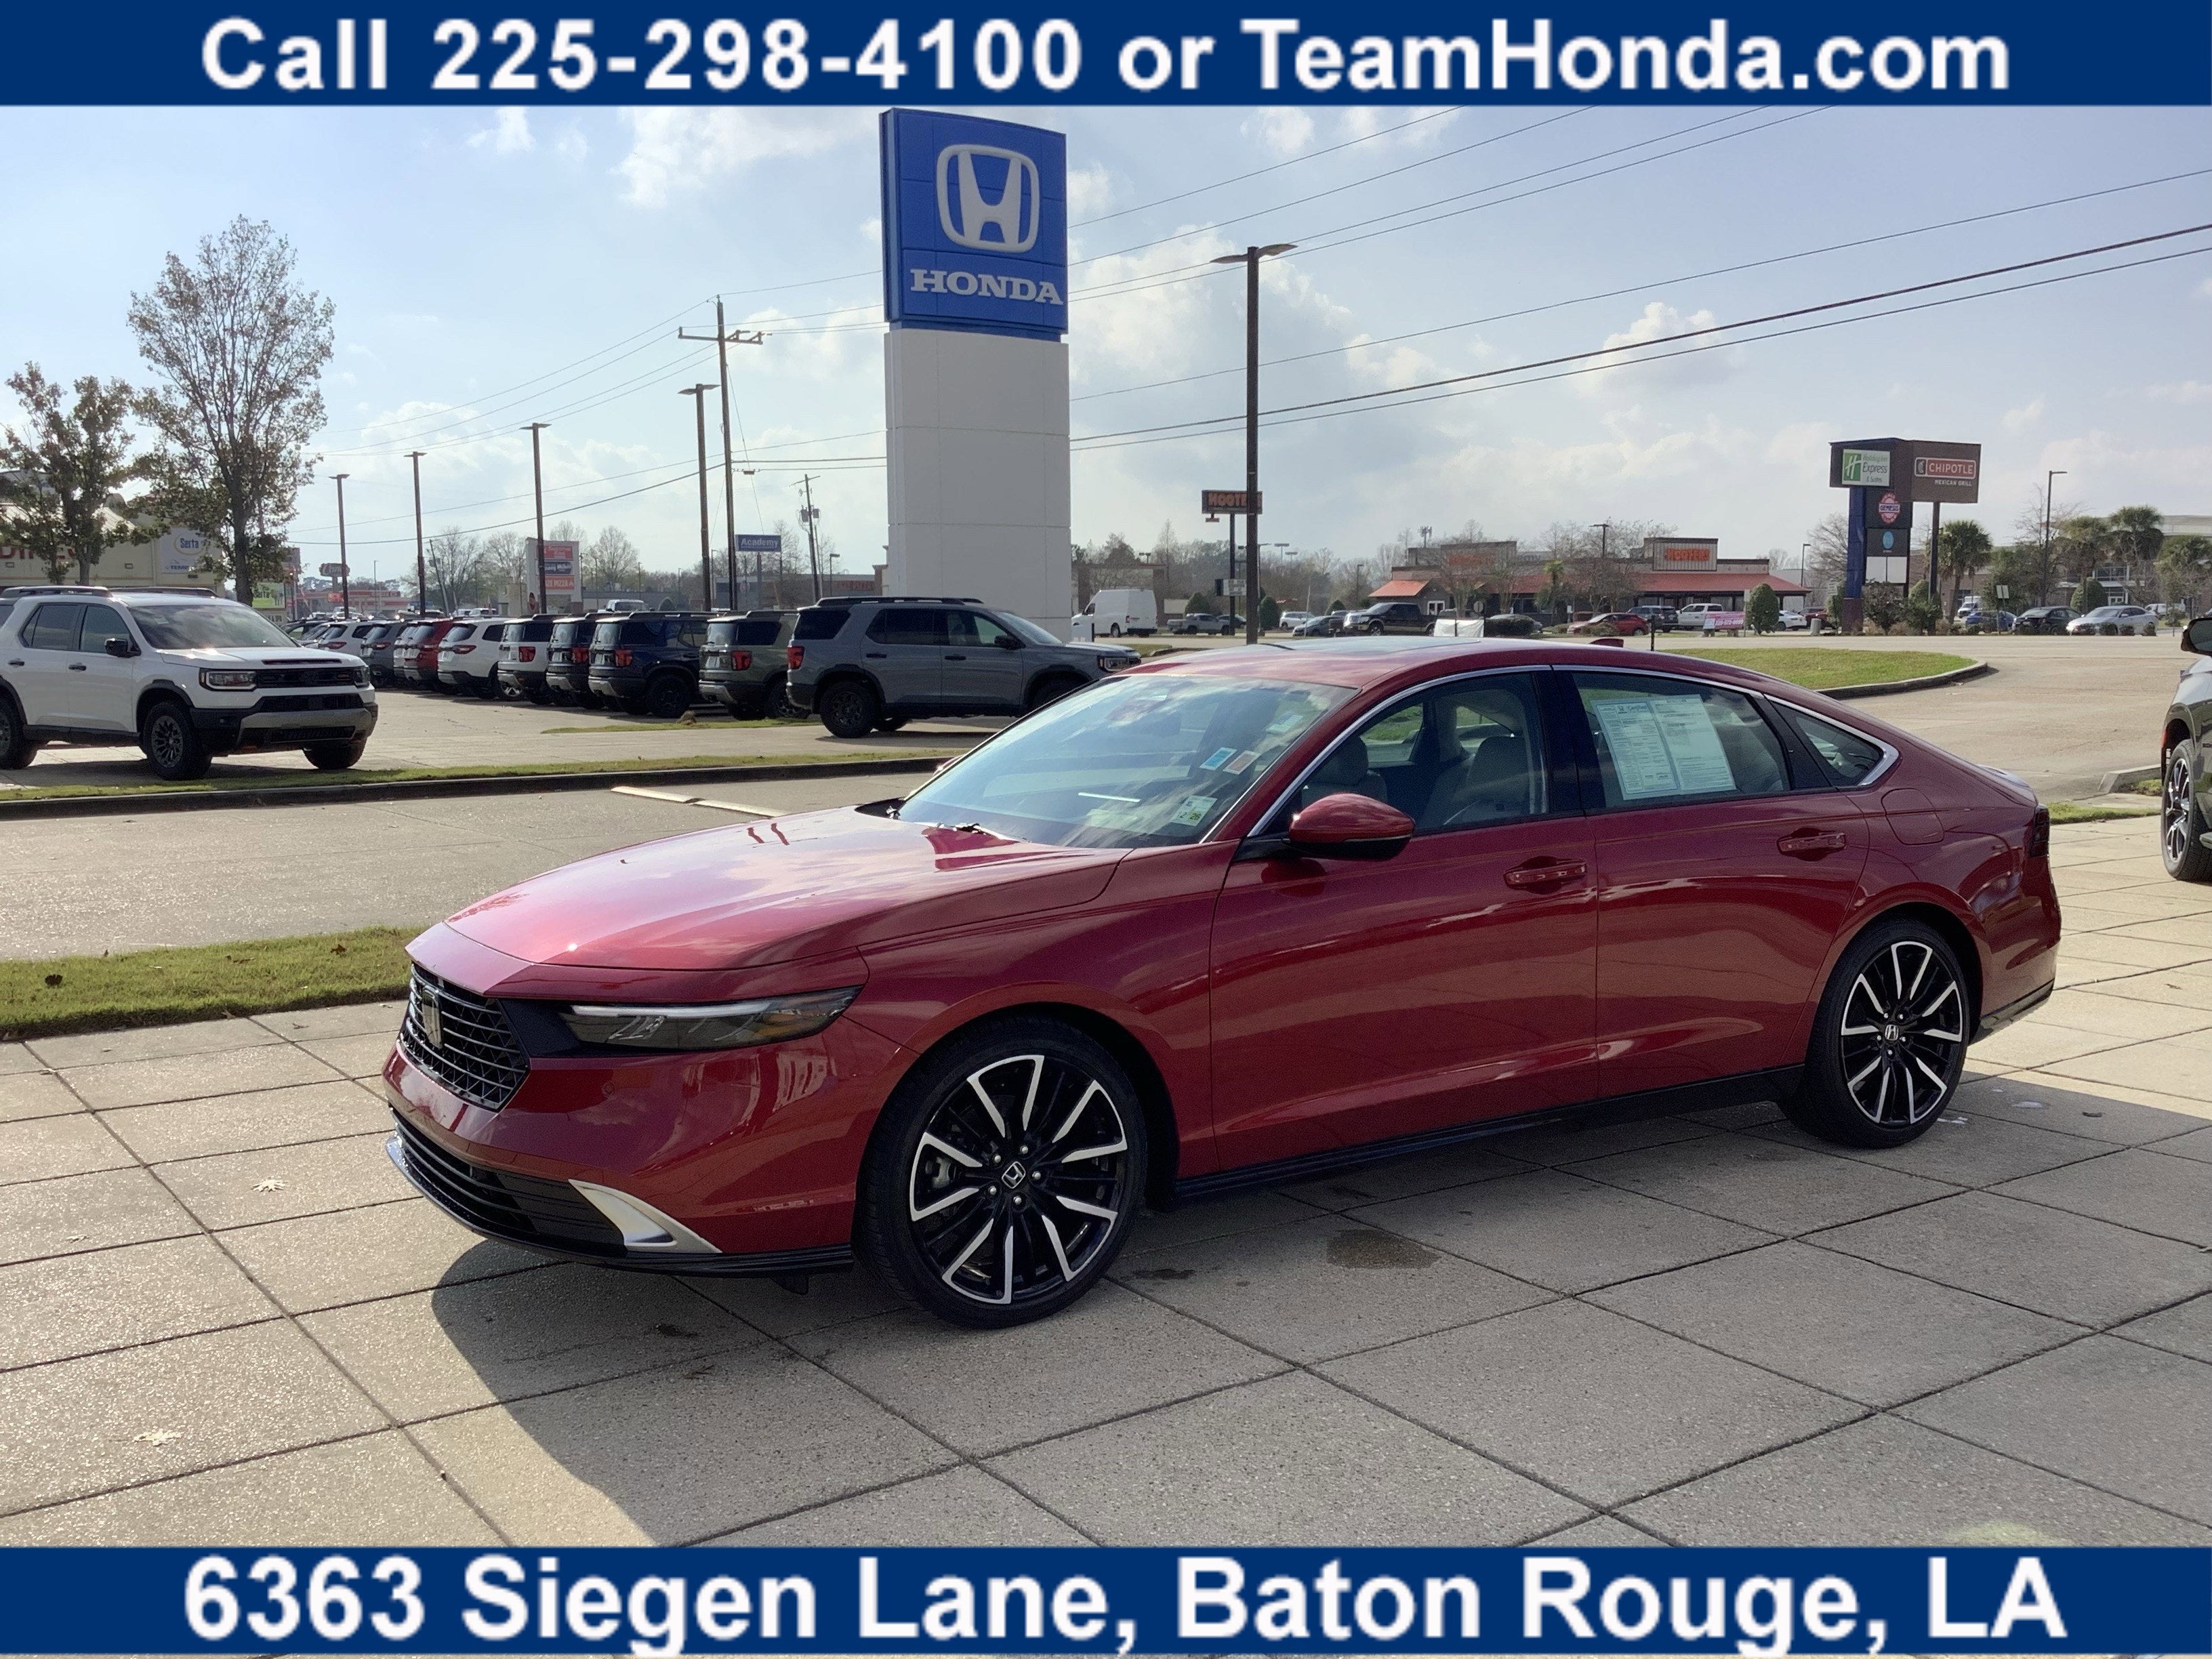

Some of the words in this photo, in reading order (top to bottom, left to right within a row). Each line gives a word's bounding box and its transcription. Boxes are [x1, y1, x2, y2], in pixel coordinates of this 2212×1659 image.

[910, 268, 1064, 306] HONDA
[1862, 462, 1887, 474] Express
[1929, 462, 1973, 474] CHIPOTLE
[1208, 493, 1262, 506] HOOTE
[180, 537, 199, 548] Serta
[741, 537, 779, 548] Academy
[1665, 548, 1711, 560] HOOTERS
